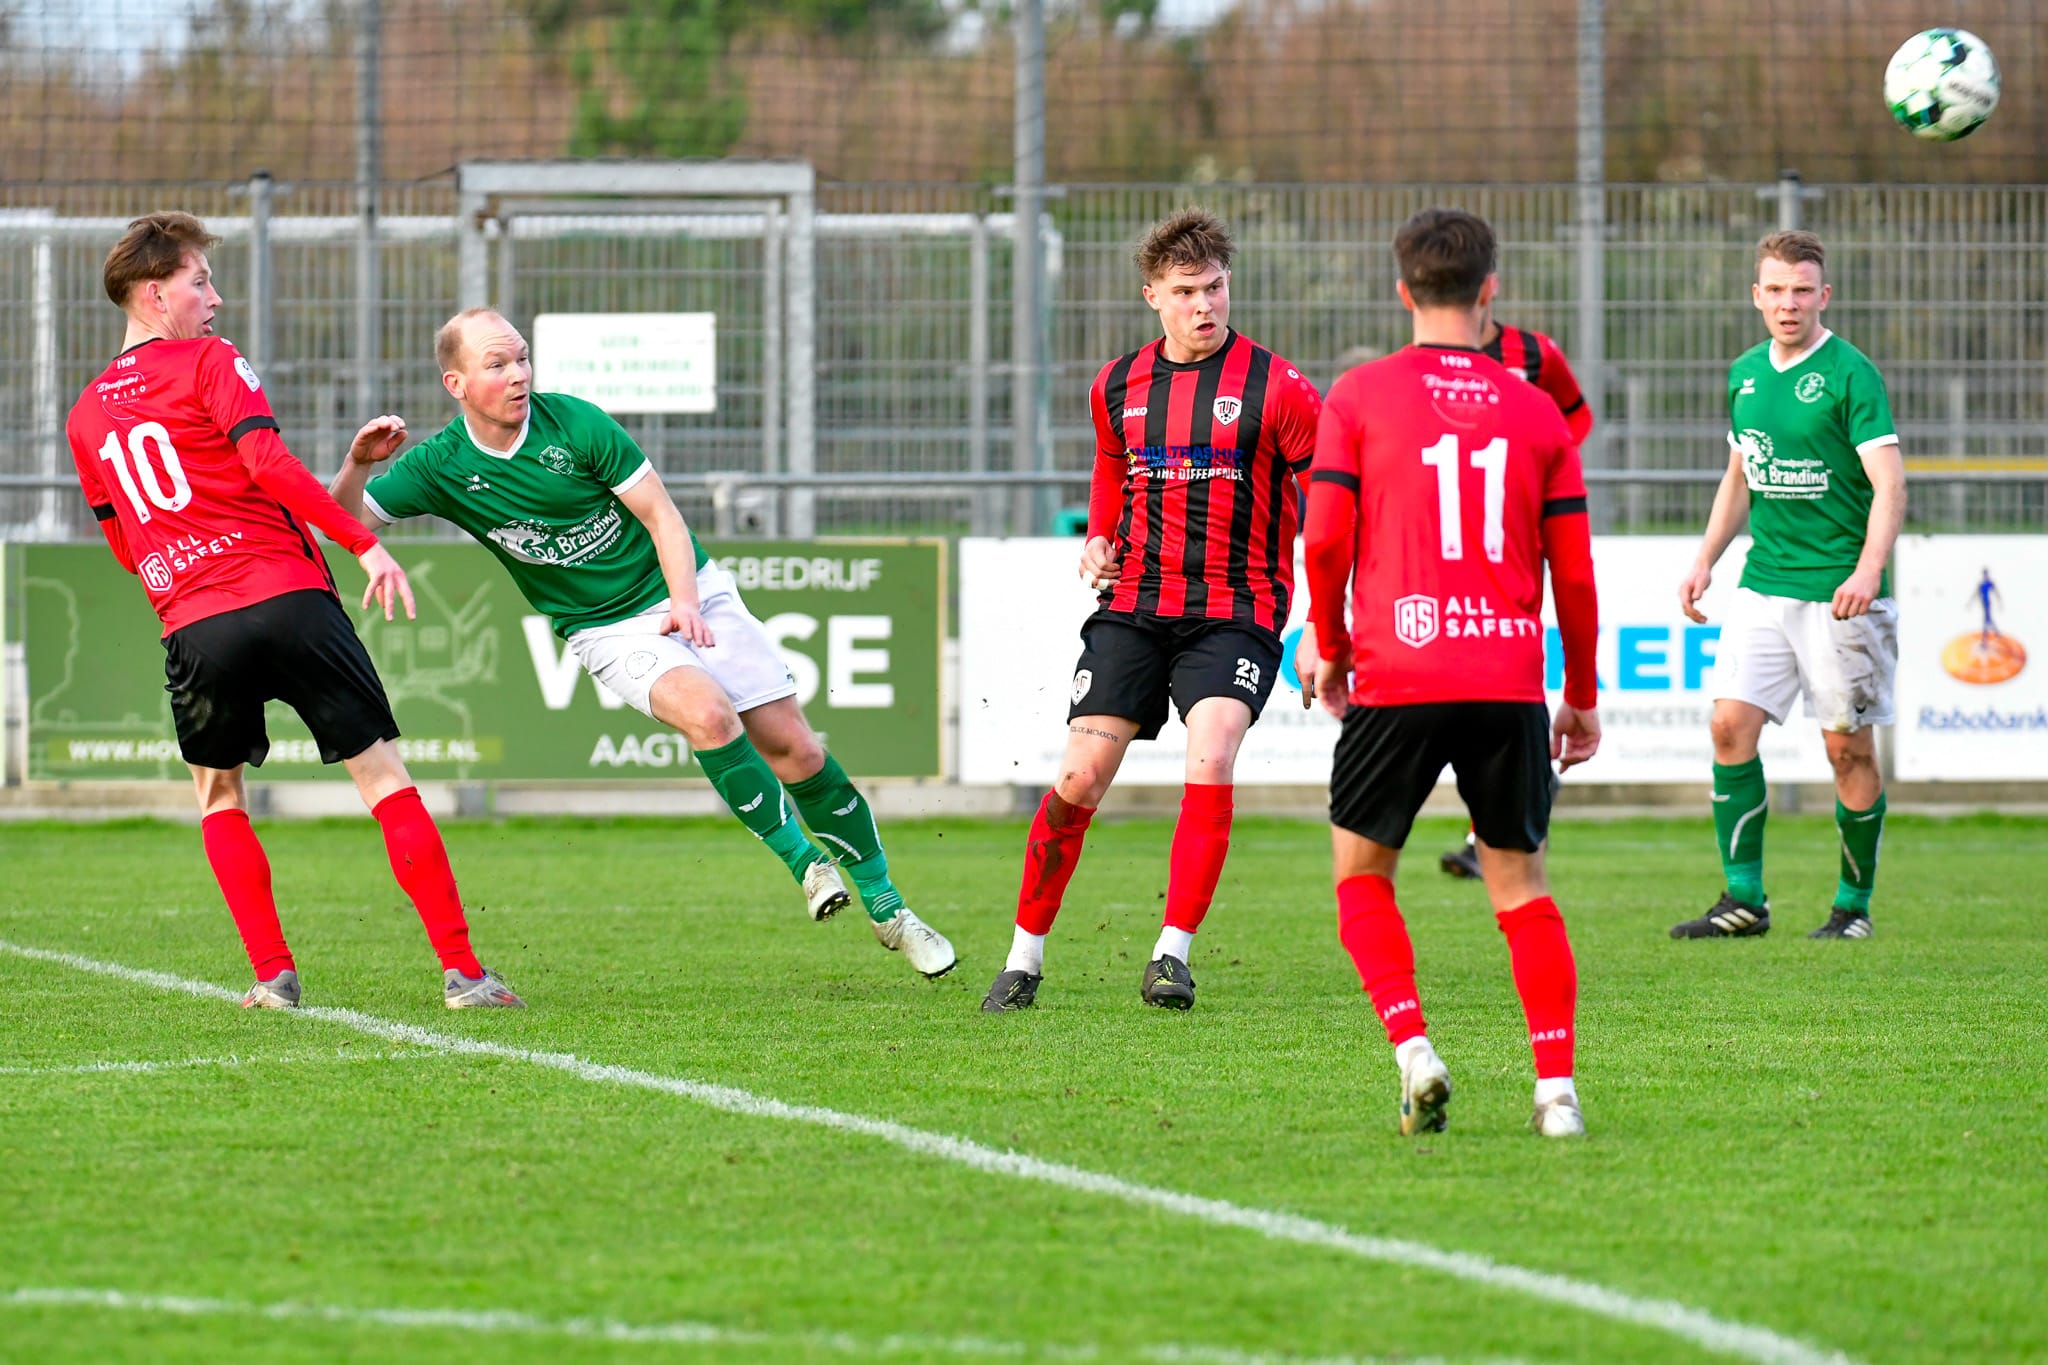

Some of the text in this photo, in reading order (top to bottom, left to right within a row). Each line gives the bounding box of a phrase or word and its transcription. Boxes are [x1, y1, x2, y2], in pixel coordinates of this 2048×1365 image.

[116, 355, 136, 369] 1920
[1122, 407, 1148, 418] JAKO
[98, 421, 193, 525] 10
[1156, 467, 1176, 479] THE
[1178, 467, 1244, 480] DIFFERENCE
[1421, 433, 1508, 563] 11
[165, 533, 202, 558] ALL
[1444, 596, 1495, 616] ALL
[1444, 618, 1538, 639] SAFETY
[1235, 657, 1261, 685] 23
[1233, 676, 1258, 695] JAKO
[1918, 705, 2048, 731] Rabobank
[1384, 998, 1417, 1020] JAKO
[1532, 1028, 1567, 1042] JAKO
